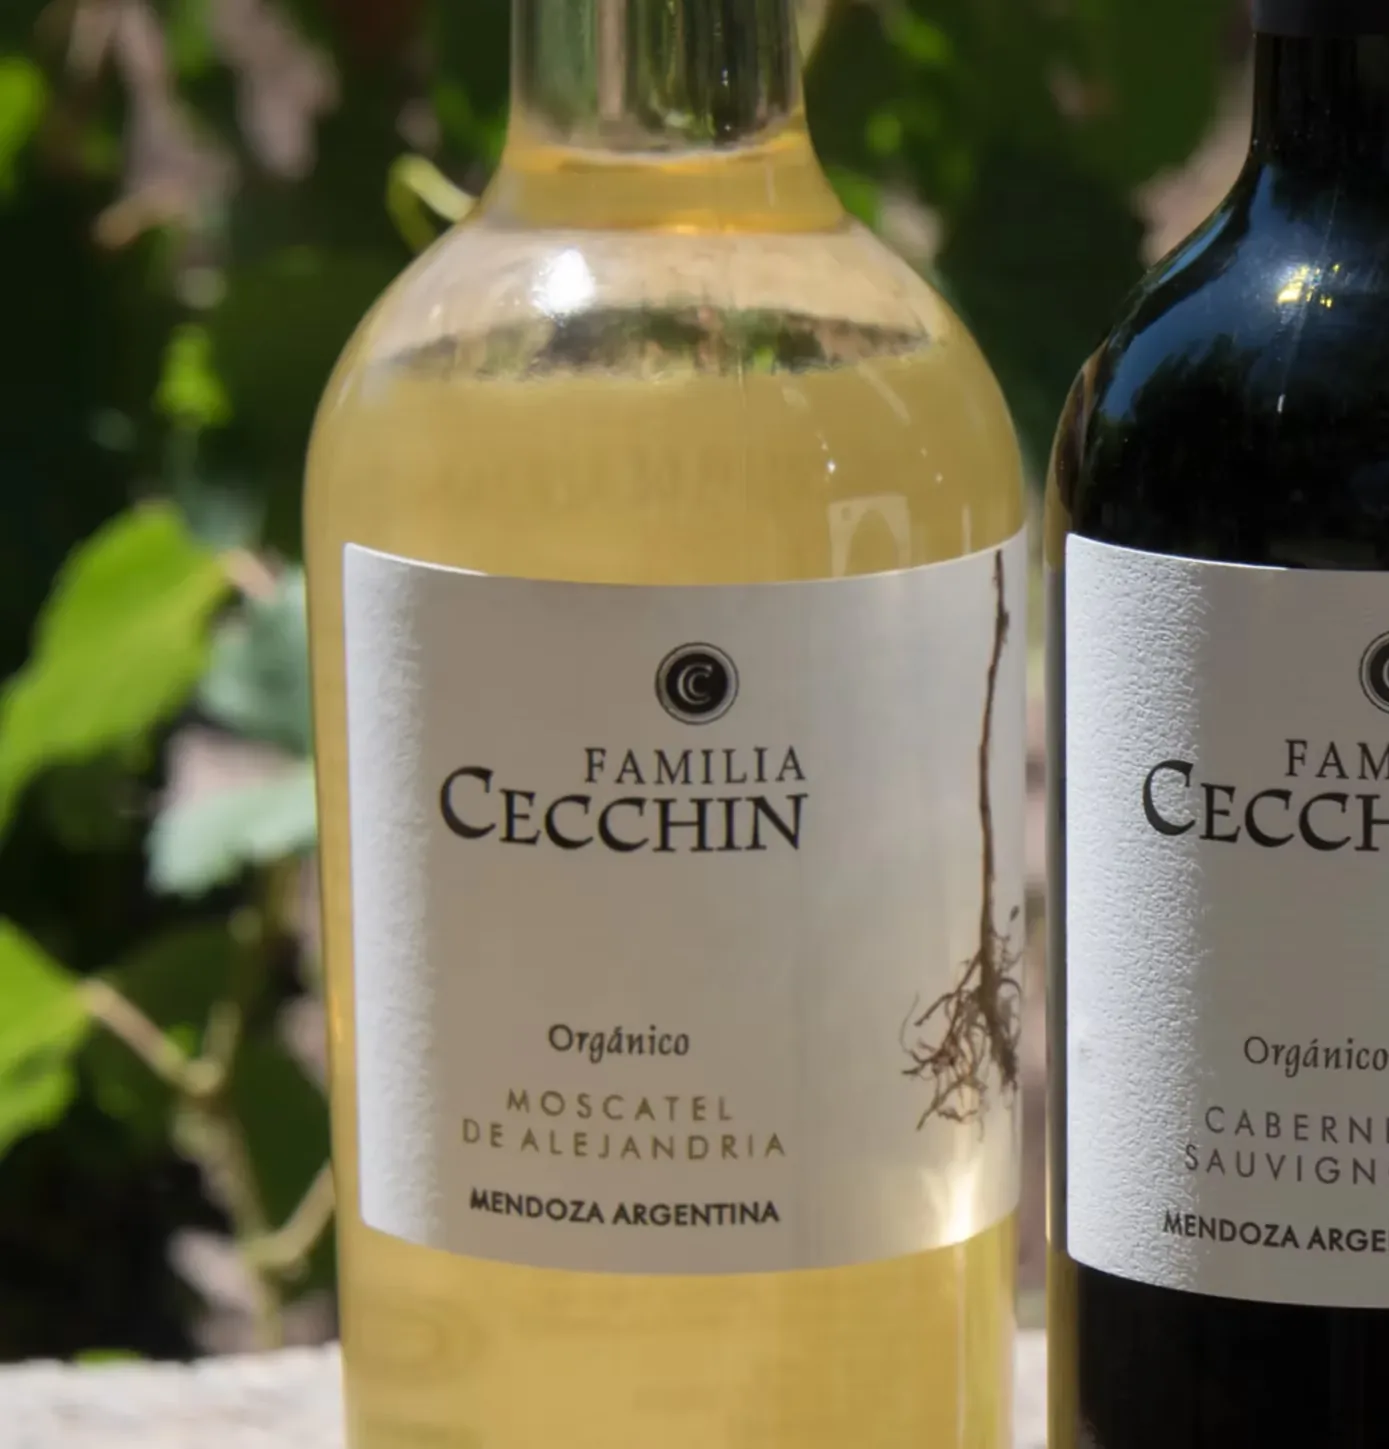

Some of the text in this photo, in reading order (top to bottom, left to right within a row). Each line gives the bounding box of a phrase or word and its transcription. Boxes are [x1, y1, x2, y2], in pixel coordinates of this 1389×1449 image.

[584, 746, 807, 785] FAMILIA
[440, 766, 809, 852] CECCHIN
[548, 1024, 690, 1063] Orgánico
[1243, 1036, 1389, 1077] Orgánico
[506, 1088, 733, 1122] MOSCATEL
[462, 1119, 787, 1160] DE ALEJANDRIA
[470, 1187, 780, 1227] MENDOZA ARGENTINA
[1163, 1209, 1300, 1249] MENDOZA
